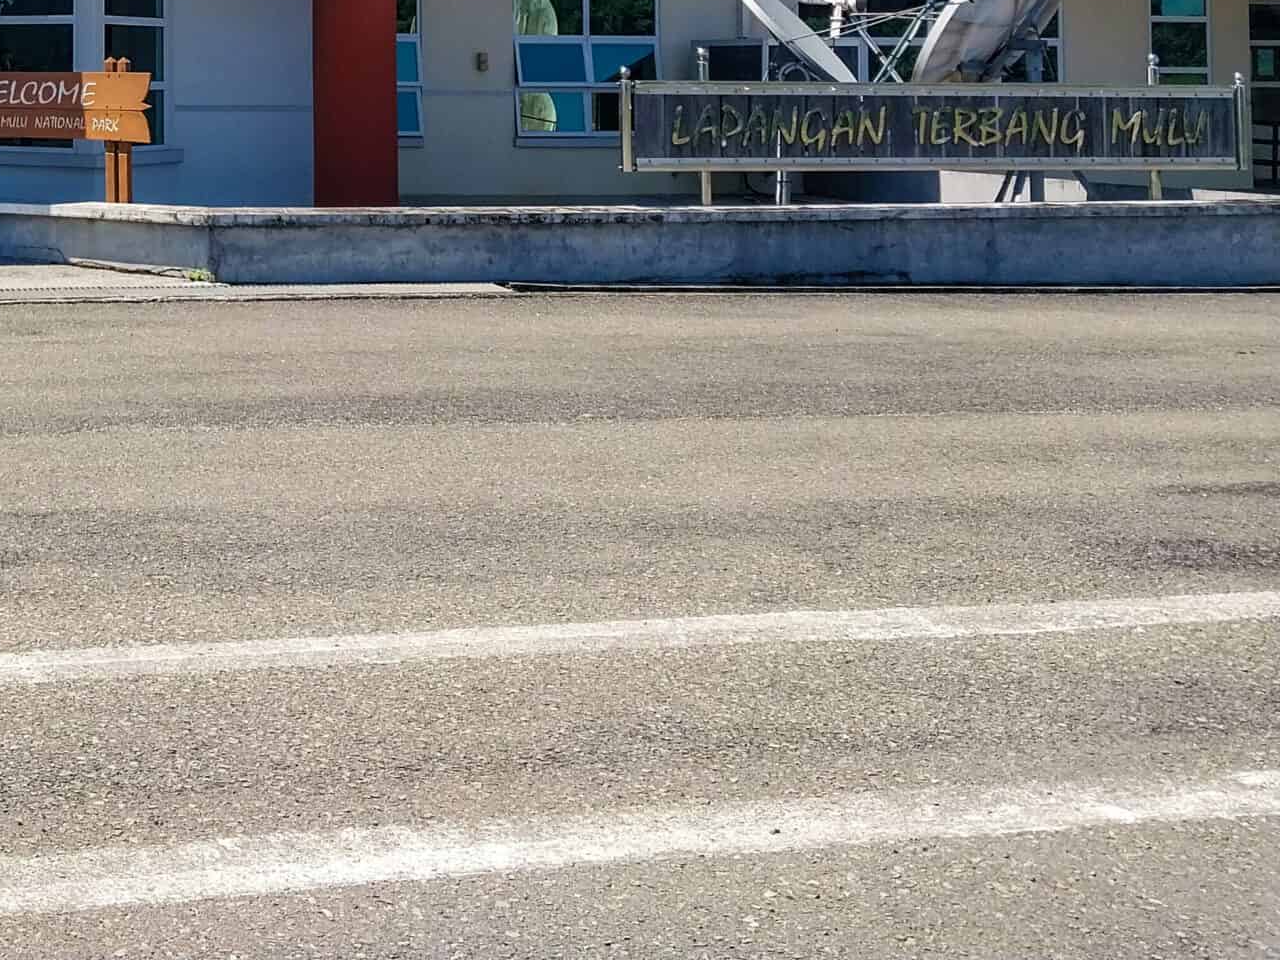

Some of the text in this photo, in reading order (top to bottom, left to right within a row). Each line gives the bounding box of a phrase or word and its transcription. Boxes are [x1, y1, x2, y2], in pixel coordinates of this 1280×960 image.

[0, 115, 28, 129] MULU
[34, 115, 86, 130] NATIONAL
[91, 117, 120, 132] PARK
[912, 105, 1087, 153] TERBANG
[1112, 106, 1209, 146] MULU
